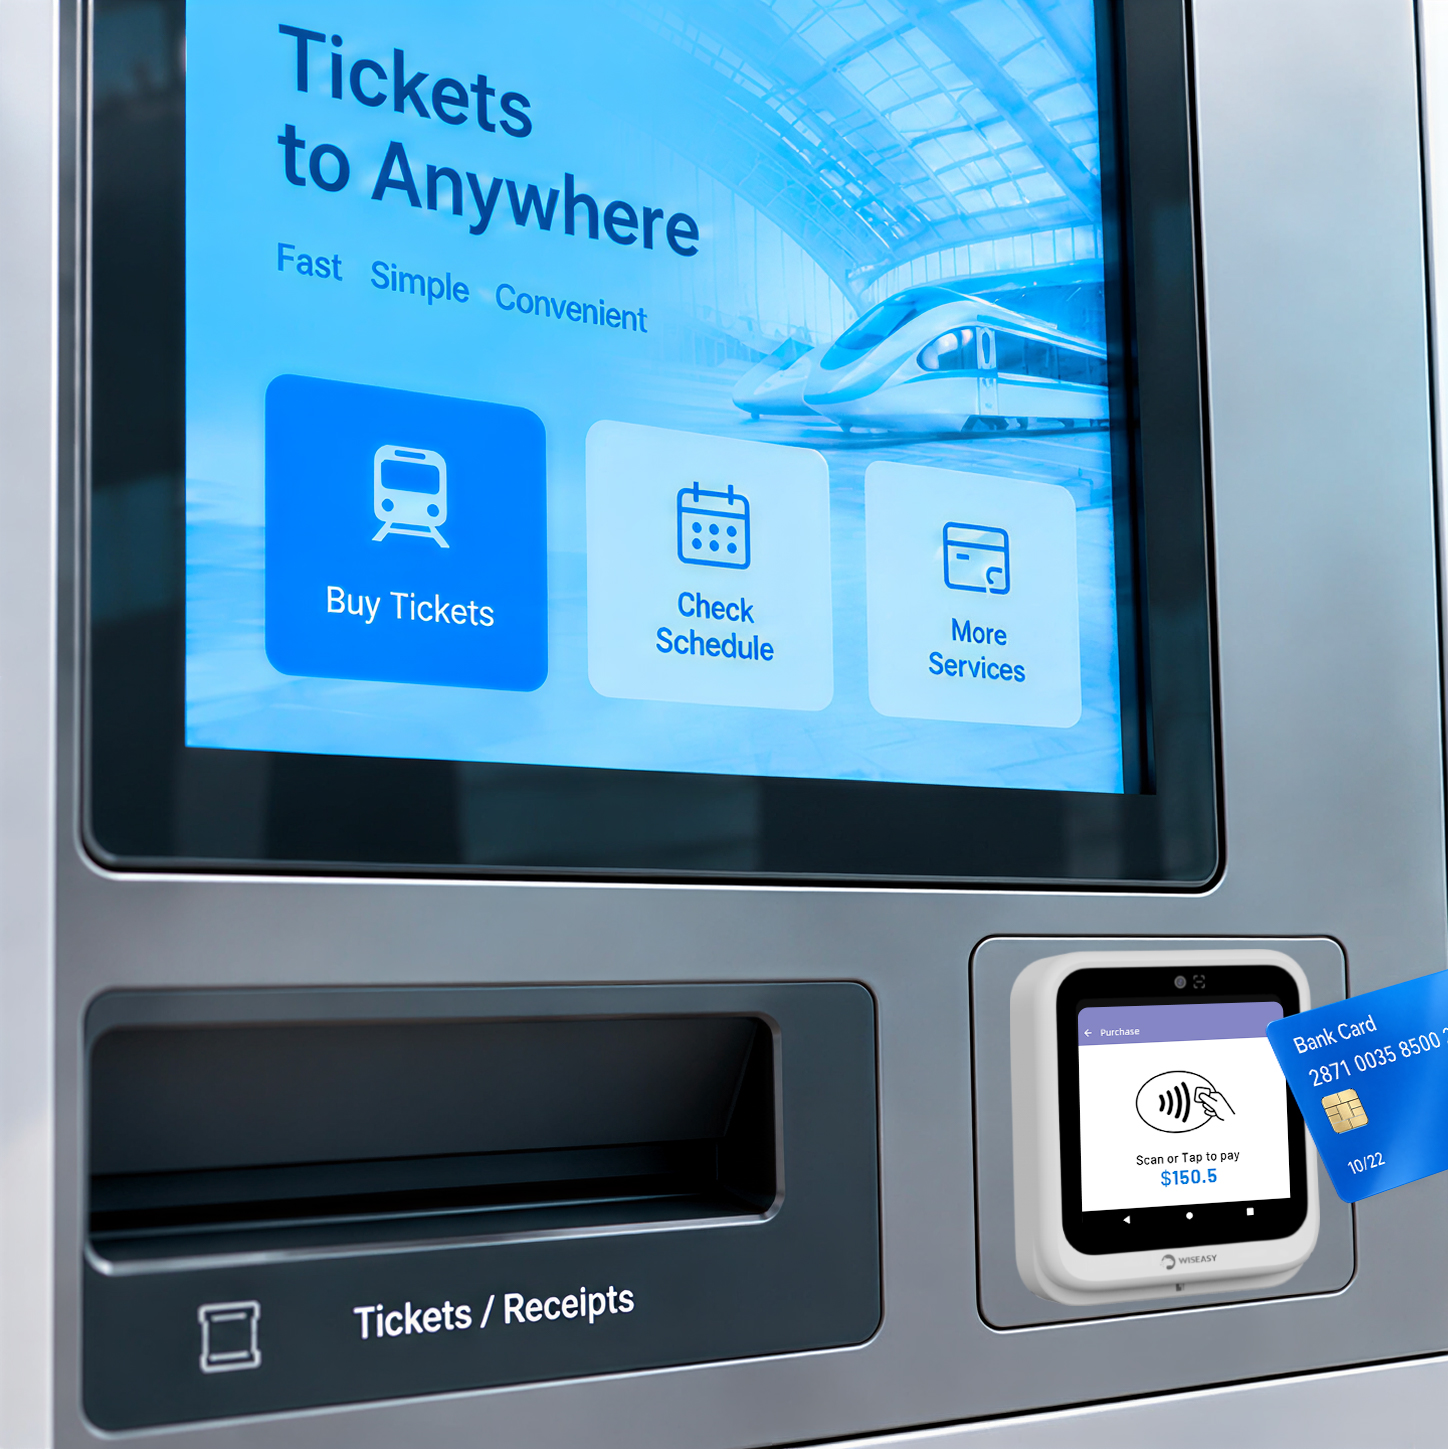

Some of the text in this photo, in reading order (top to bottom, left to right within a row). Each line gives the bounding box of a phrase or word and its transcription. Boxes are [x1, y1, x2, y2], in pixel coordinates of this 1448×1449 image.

[278, 23, 533, 138] Tickets
[277, 123, 700, 257] to Anywhere
[276, 242, 648, 334] Fast Simple Convenient
[325, 585, 495, 628] Buy Tickets
[677, 592, 755, 625] Check
[655, 628, 775, 662] Schedule
[950, 620, 1008, 647] More
[928, 652, 1026, 684] Services
[1100, 1026, 1140, 1037] Purchase
[1293, 1014, 1378, 1054] Bank Card
[1308, 1059, 1352, 1087] 2871
[1354, 1045, 1397, 1072] 0035
[1399, 1032, 1441, 1059] 8500
[1136, 1150, 1240, 1166] Scan or Tap to pay
[1347, 1151, 1386, 1175] 10/22
[1160, 1168, 1217, 1187] $150.5
[1178, 1253, 1218, 1265] WISEASY
[353, 1299, 472, 1340] Tickets
[503, 1285, 635, 1325] Receipts
